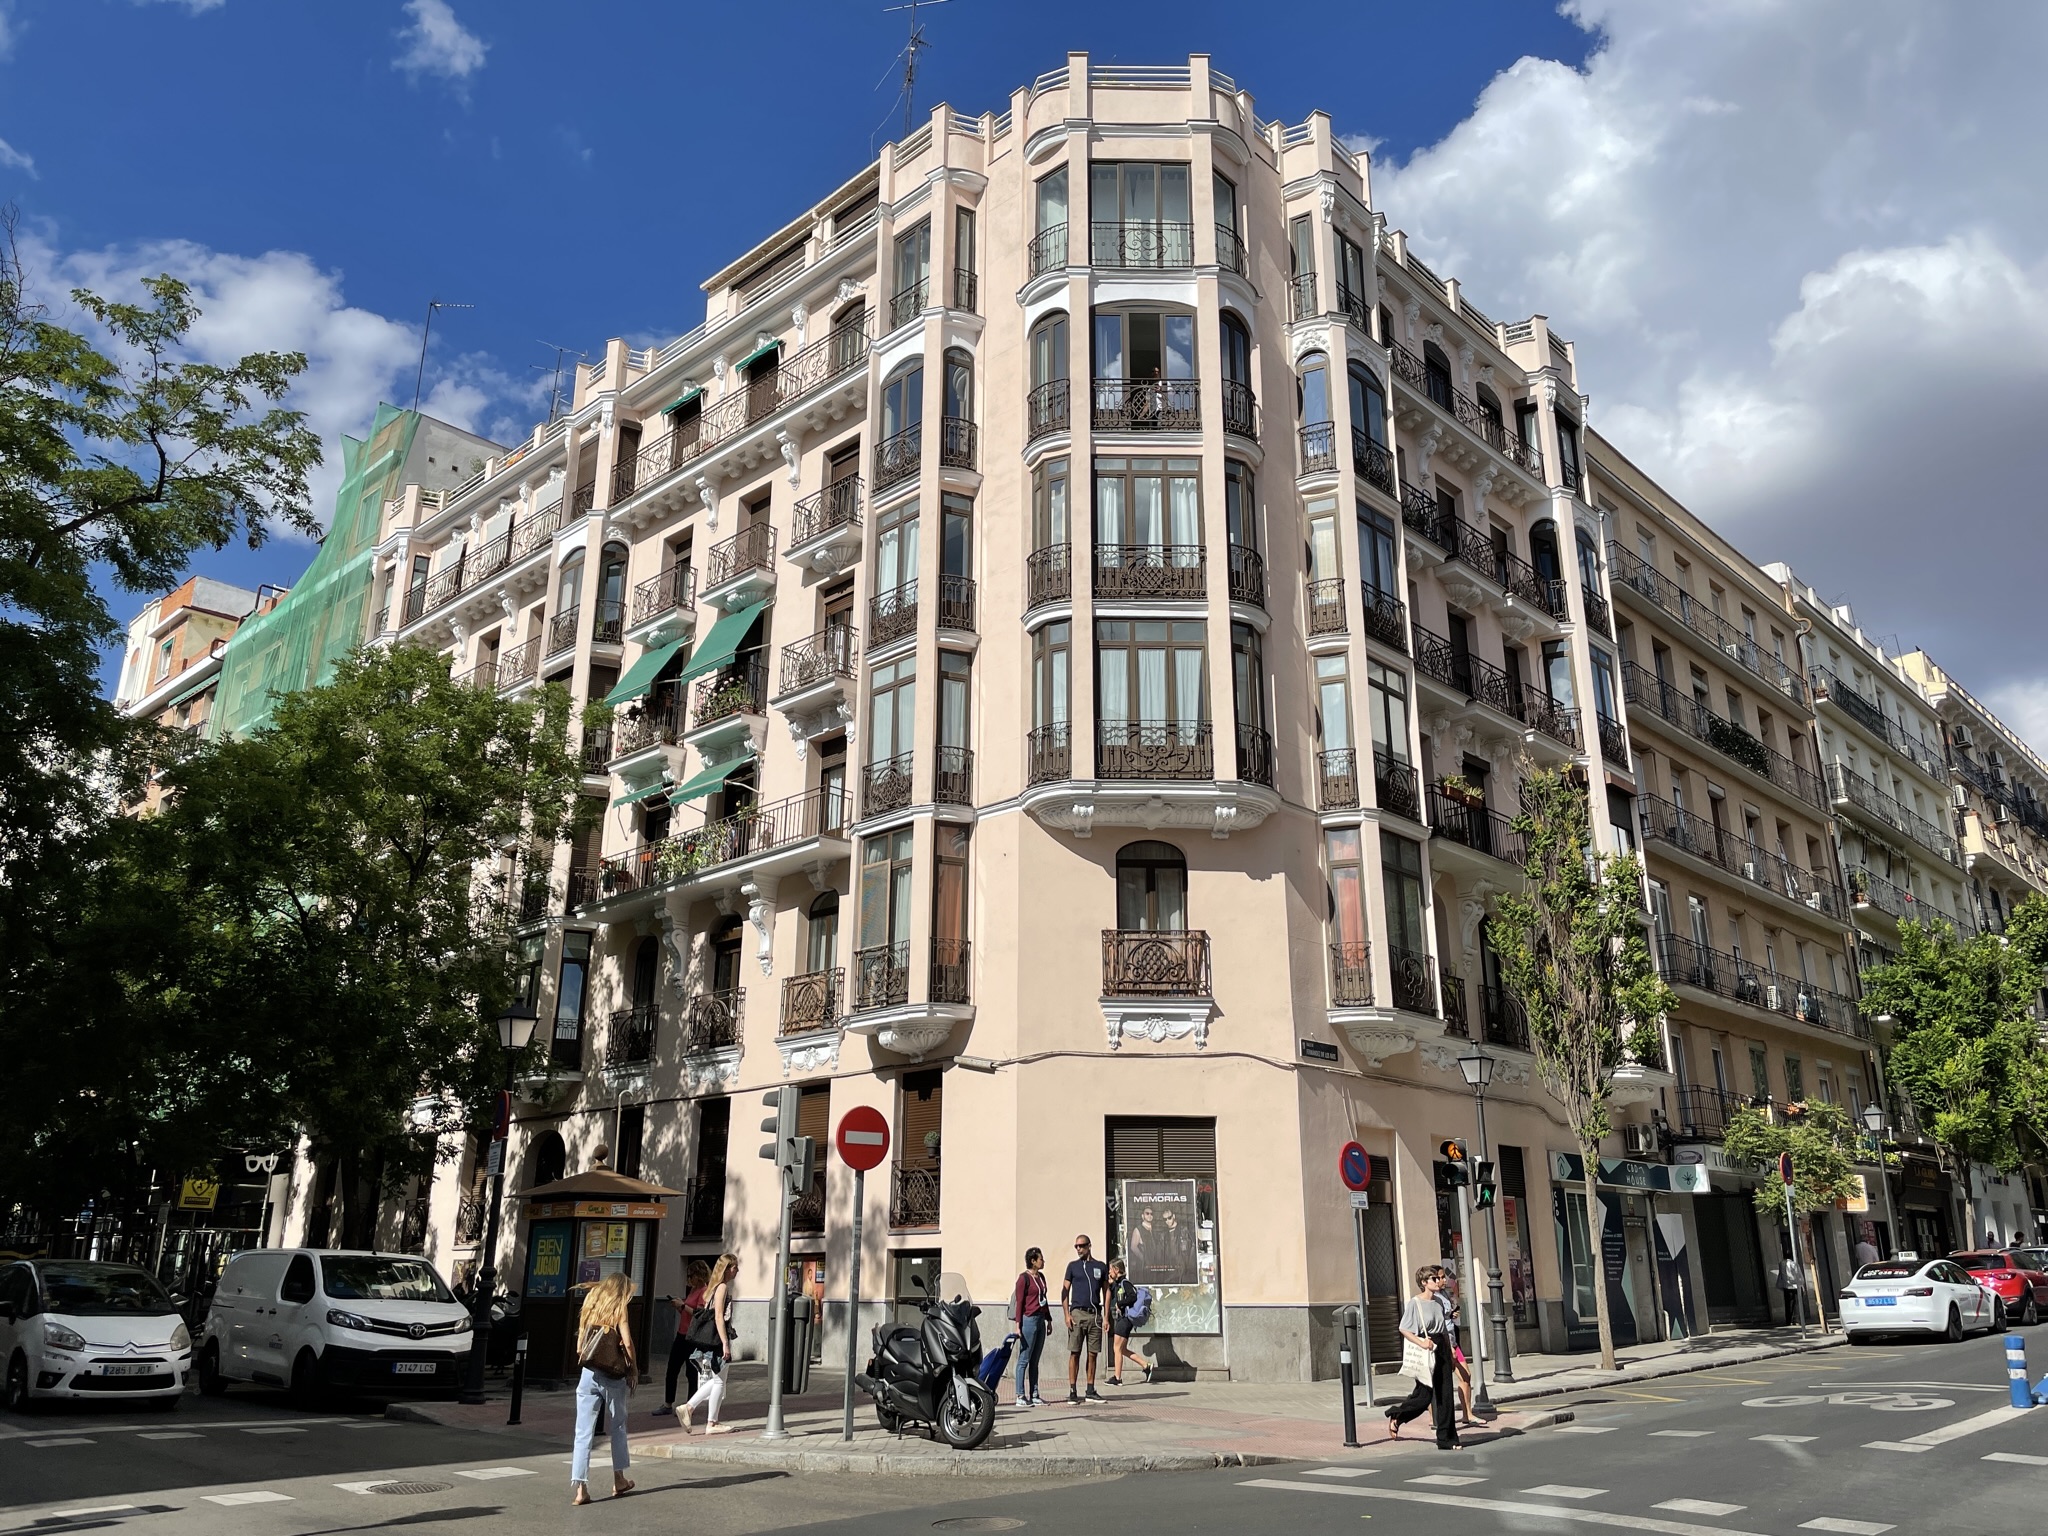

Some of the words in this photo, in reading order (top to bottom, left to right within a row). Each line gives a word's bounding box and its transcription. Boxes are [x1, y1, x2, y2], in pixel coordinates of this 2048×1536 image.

[1626, 1163, 1638, 1173] CBD
[1626, 1175, 1647, 1186] HOUSE
[1133, 1195, 1187, 1203] MEMORIAS
[538, 1238, 563, 1255] BIEN
[534, 1256, 561, 1276] JUGADO
[108, 1366, 132, 1375] 2851
[419, 1364, 435, 1373] LCS
